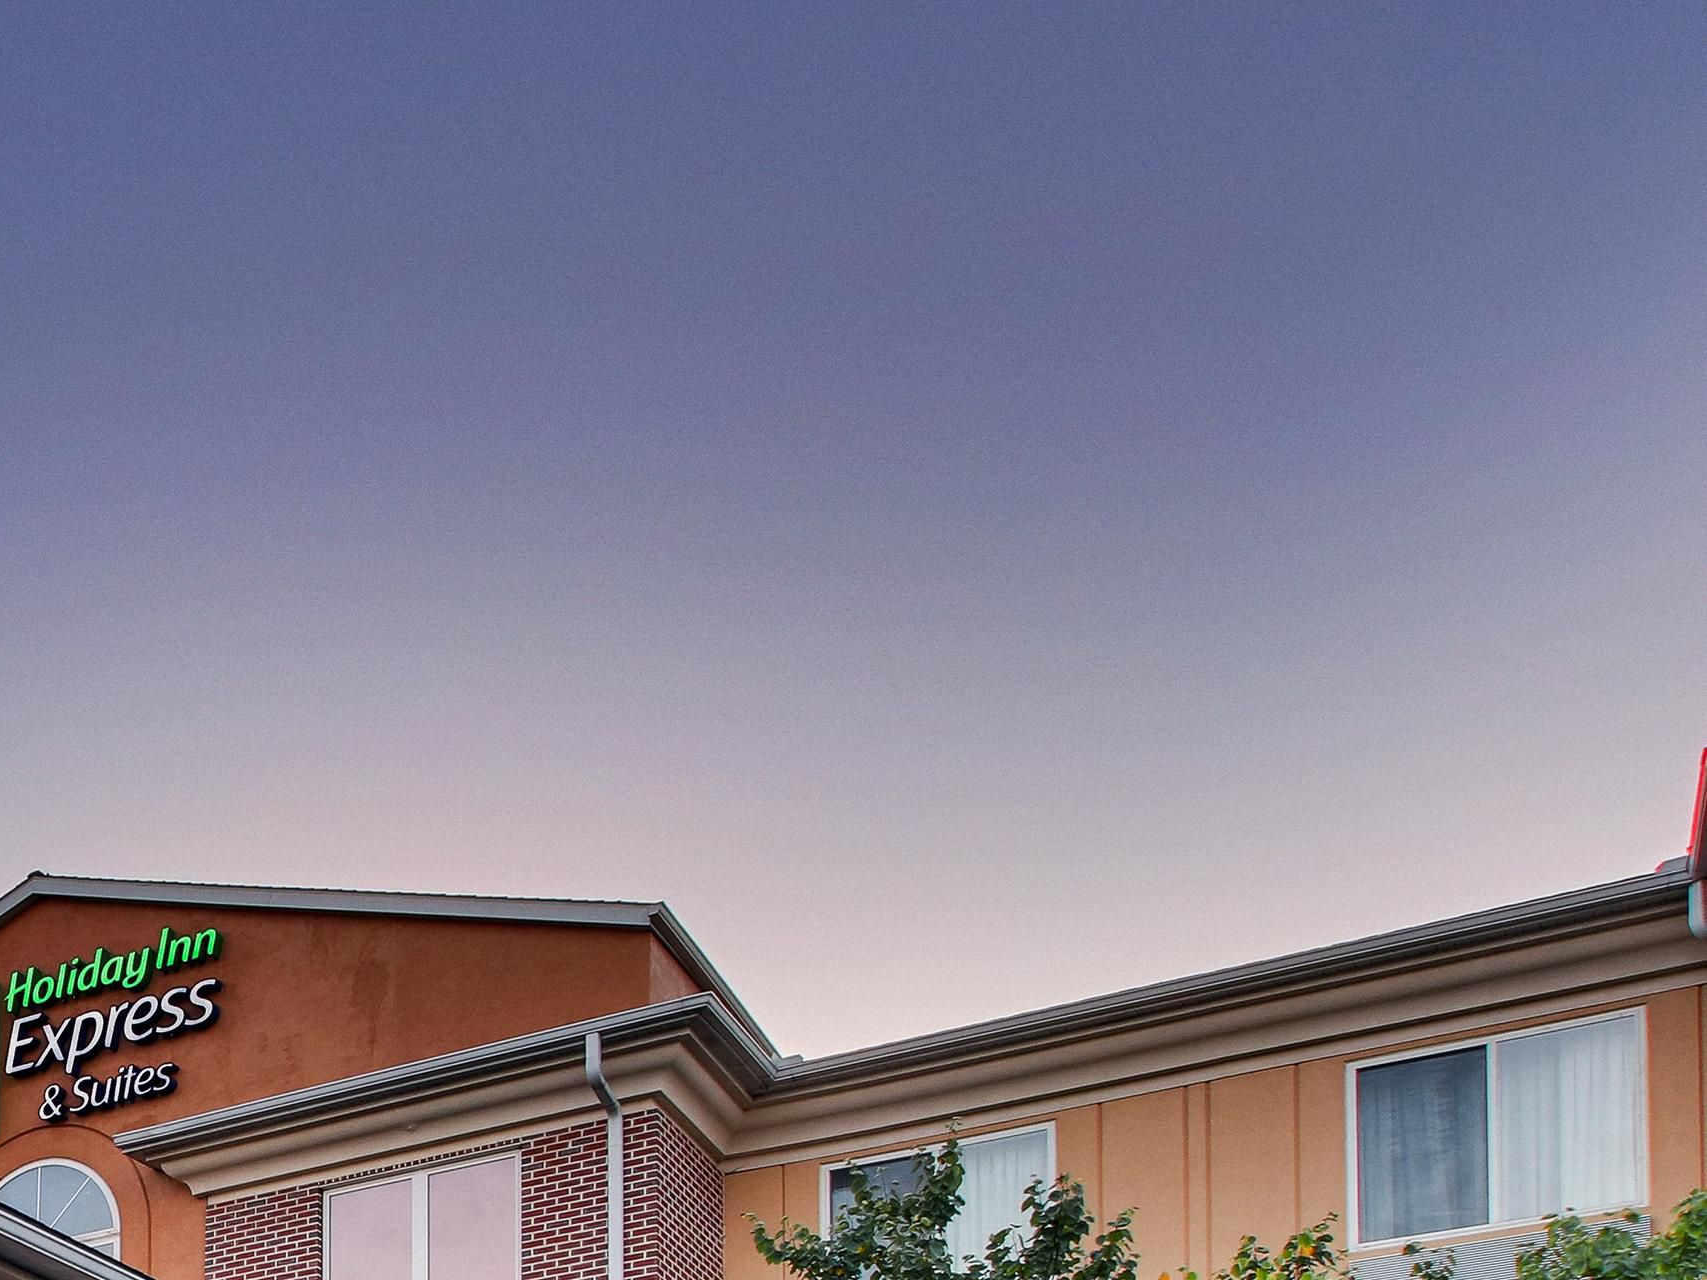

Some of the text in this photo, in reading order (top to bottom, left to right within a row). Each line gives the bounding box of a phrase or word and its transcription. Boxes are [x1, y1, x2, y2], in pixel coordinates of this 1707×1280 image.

[4, 926, 217, 1013] Holiday Inn
[5, 978, 216, 1074] Express
[38, 1063, 174, 1120] & Suites
